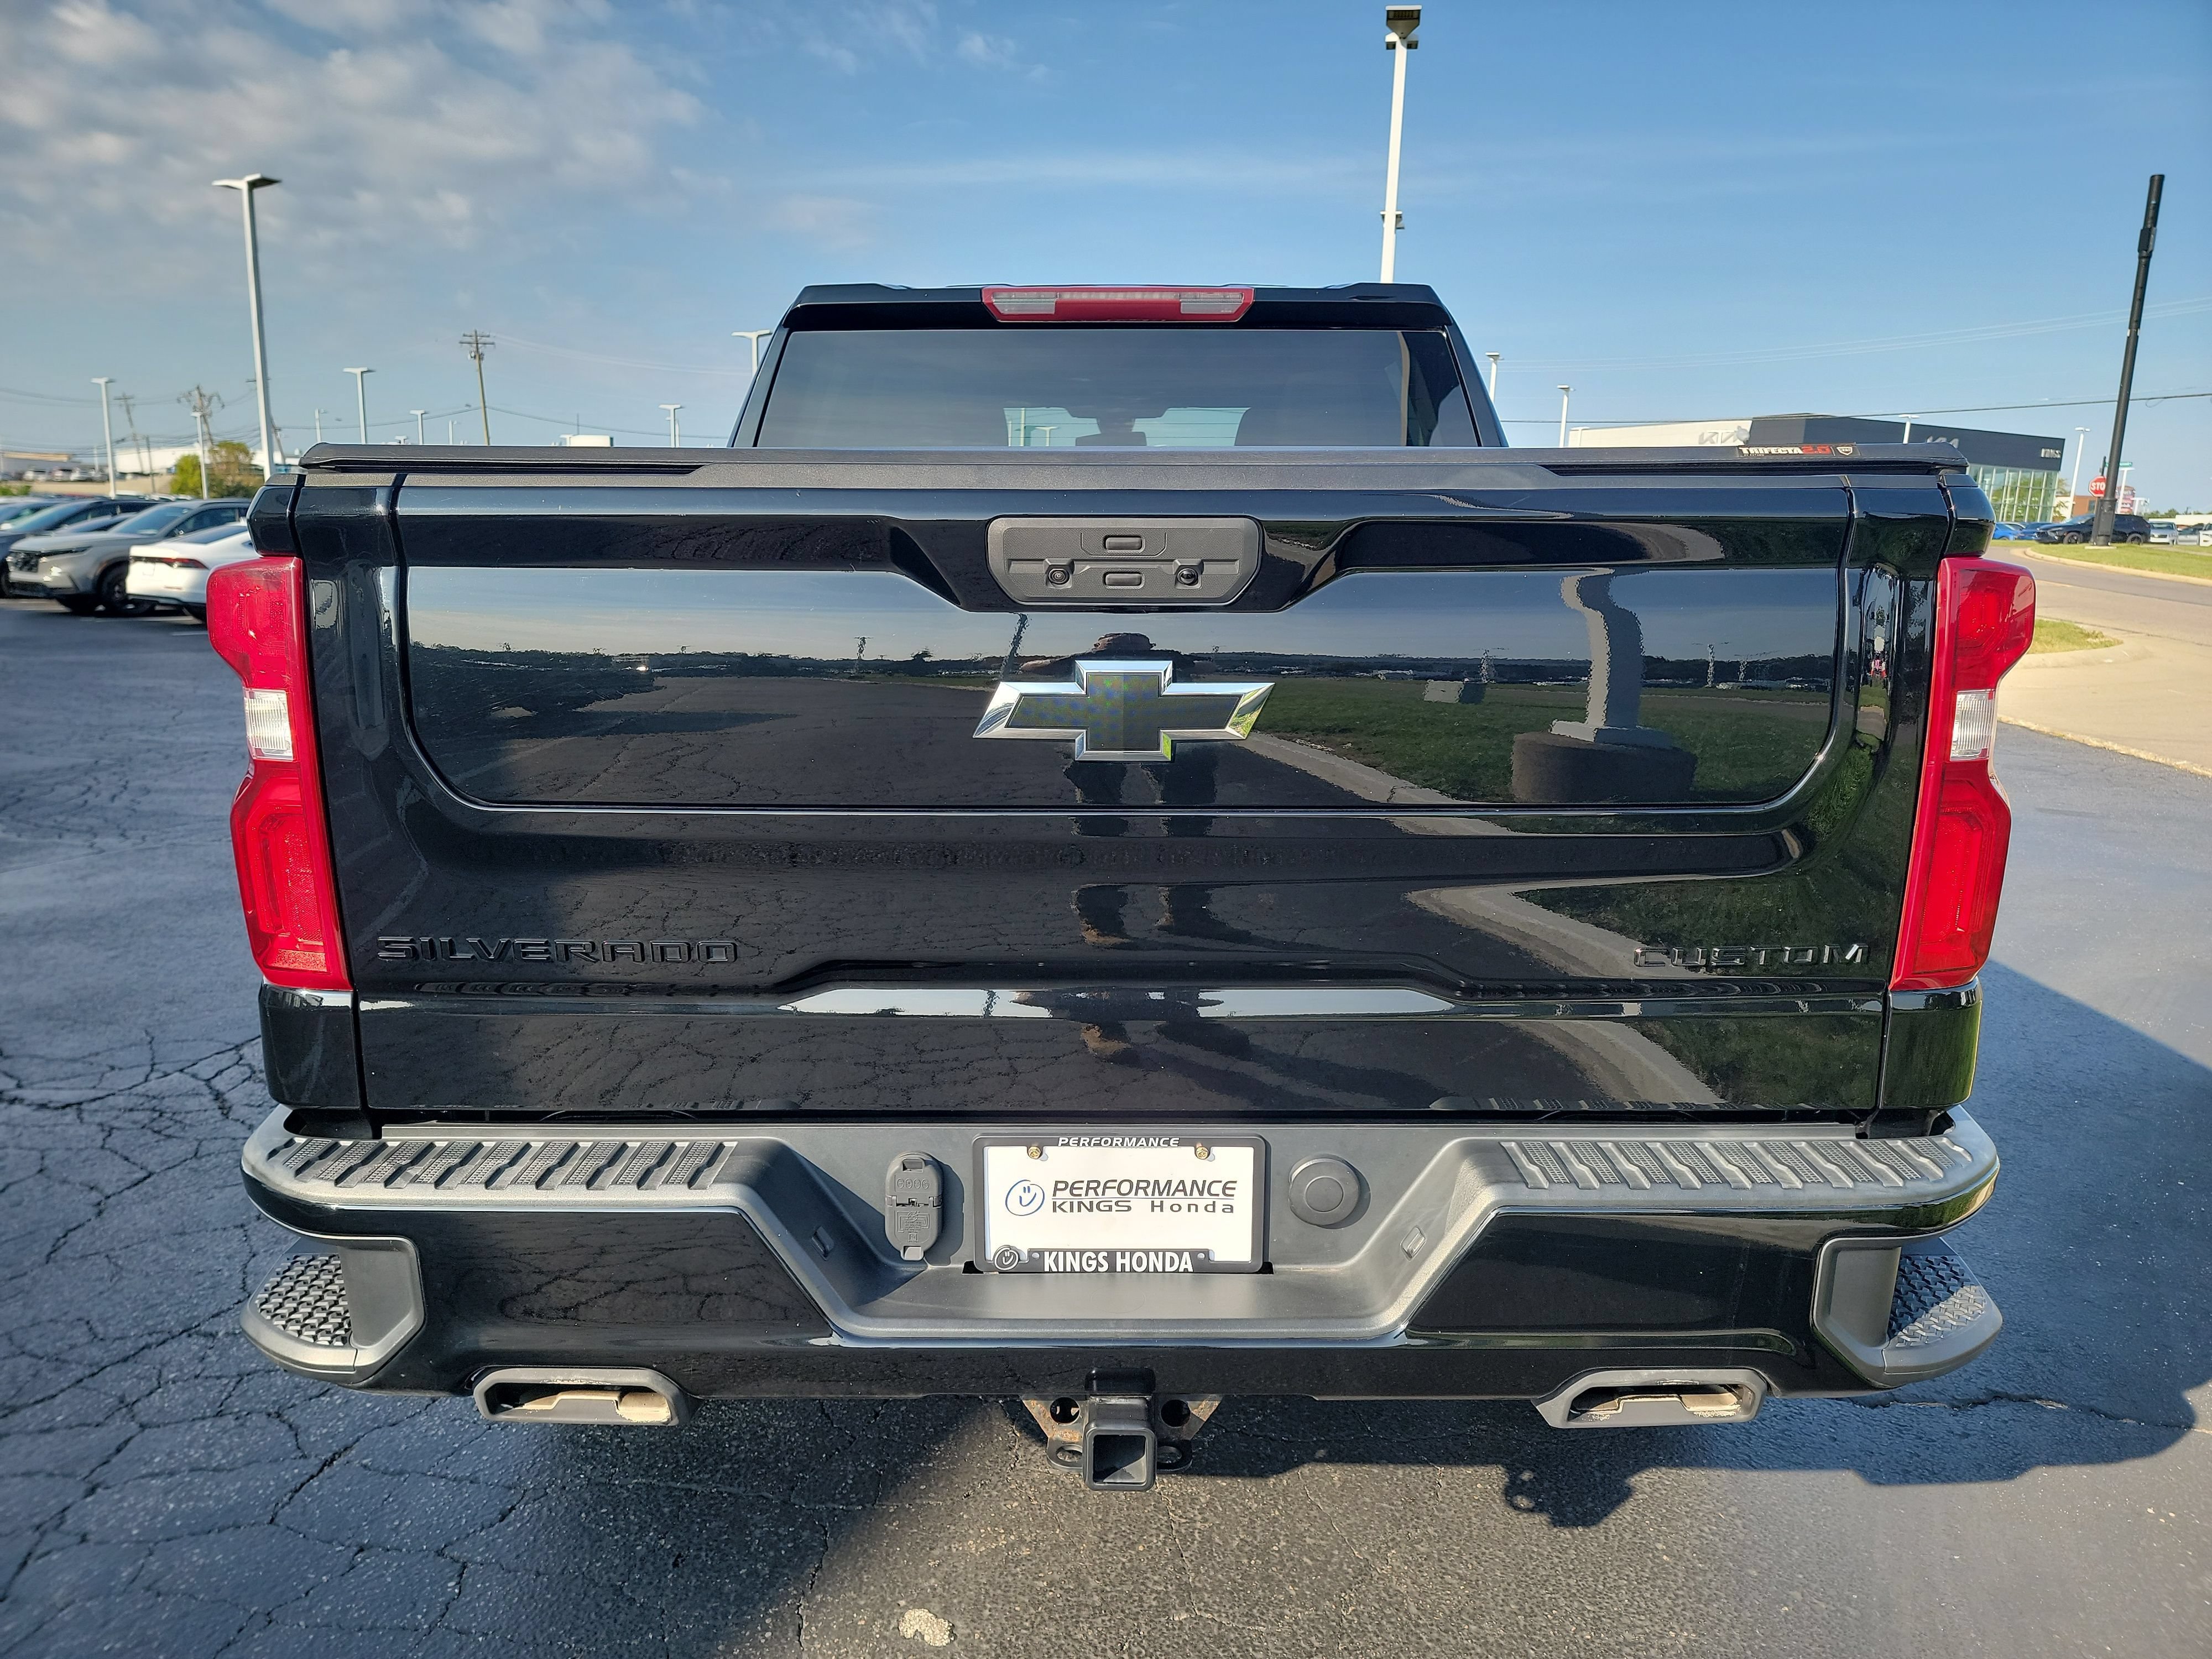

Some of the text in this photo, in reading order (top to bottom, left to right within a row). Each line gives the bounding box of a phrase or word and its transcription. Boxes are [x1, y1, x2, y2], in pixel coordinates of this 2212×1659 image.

[1802, 445, 1832, 454] 2.0
[2091, 482, 2106, 491] STO
[377, 936, 738, 963] SILVERADO
[1634, 943, 1870, 967] CUSTOM
[1058, 1137, 1180, 1147] PERFORMANCE
[1051, 1179, 1238, 1197] PERFORMANCE
[1052, 1201, 1234, 1213] KINGS Honda
[1044, 1251, 1193, 1272] KINGS HONDA
